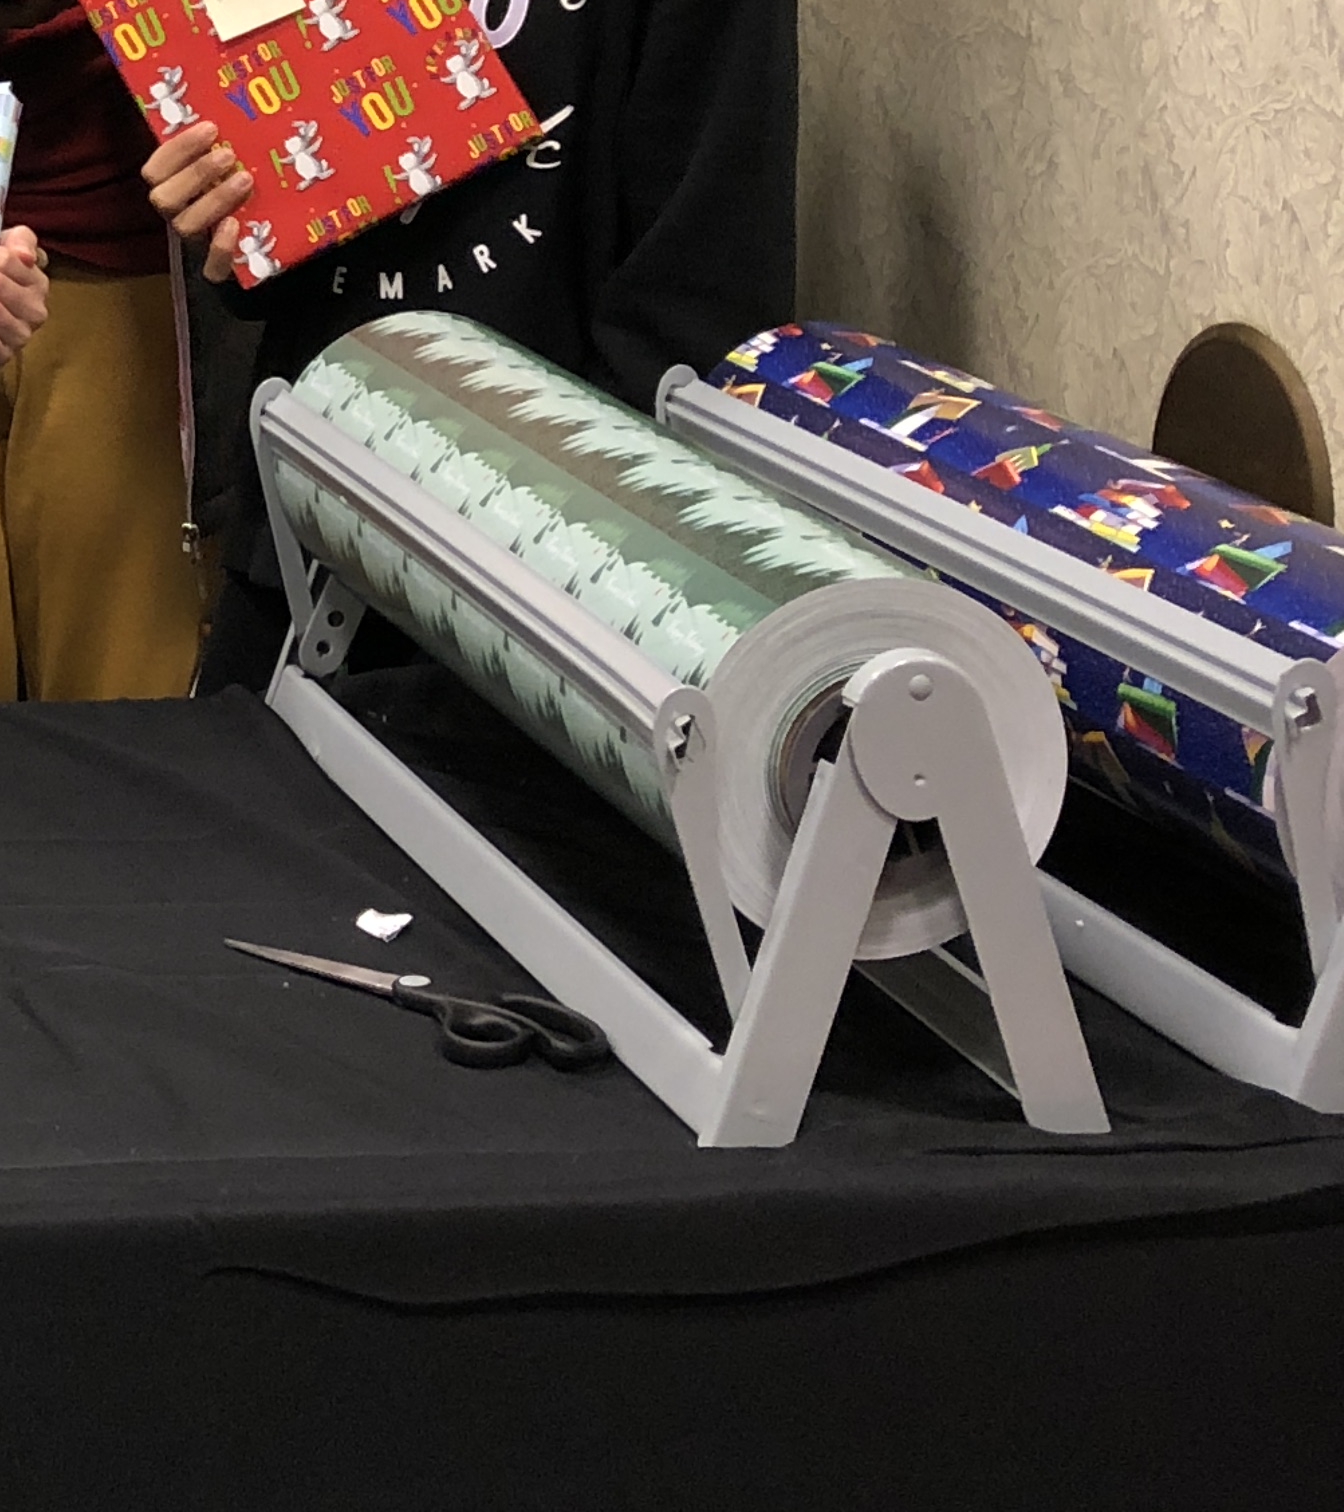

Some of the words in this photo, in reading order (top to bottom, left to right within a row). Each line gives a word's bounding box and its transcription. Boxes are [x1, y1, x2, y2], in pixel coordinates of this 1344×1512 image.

[88, 0, 119, 30] UST
[217, 54, 254, 88] JUST
[225, 59, 301, 121] YOU
[330, 69, 366, 104] JUST
[363, 54, 397, 83] FOR
[338, 75, 414, 137] YOU
[467, 123, 506, 160] JUST
[503, 110, 535, 138] FOR
[306, 208, 342, 244] JUST
